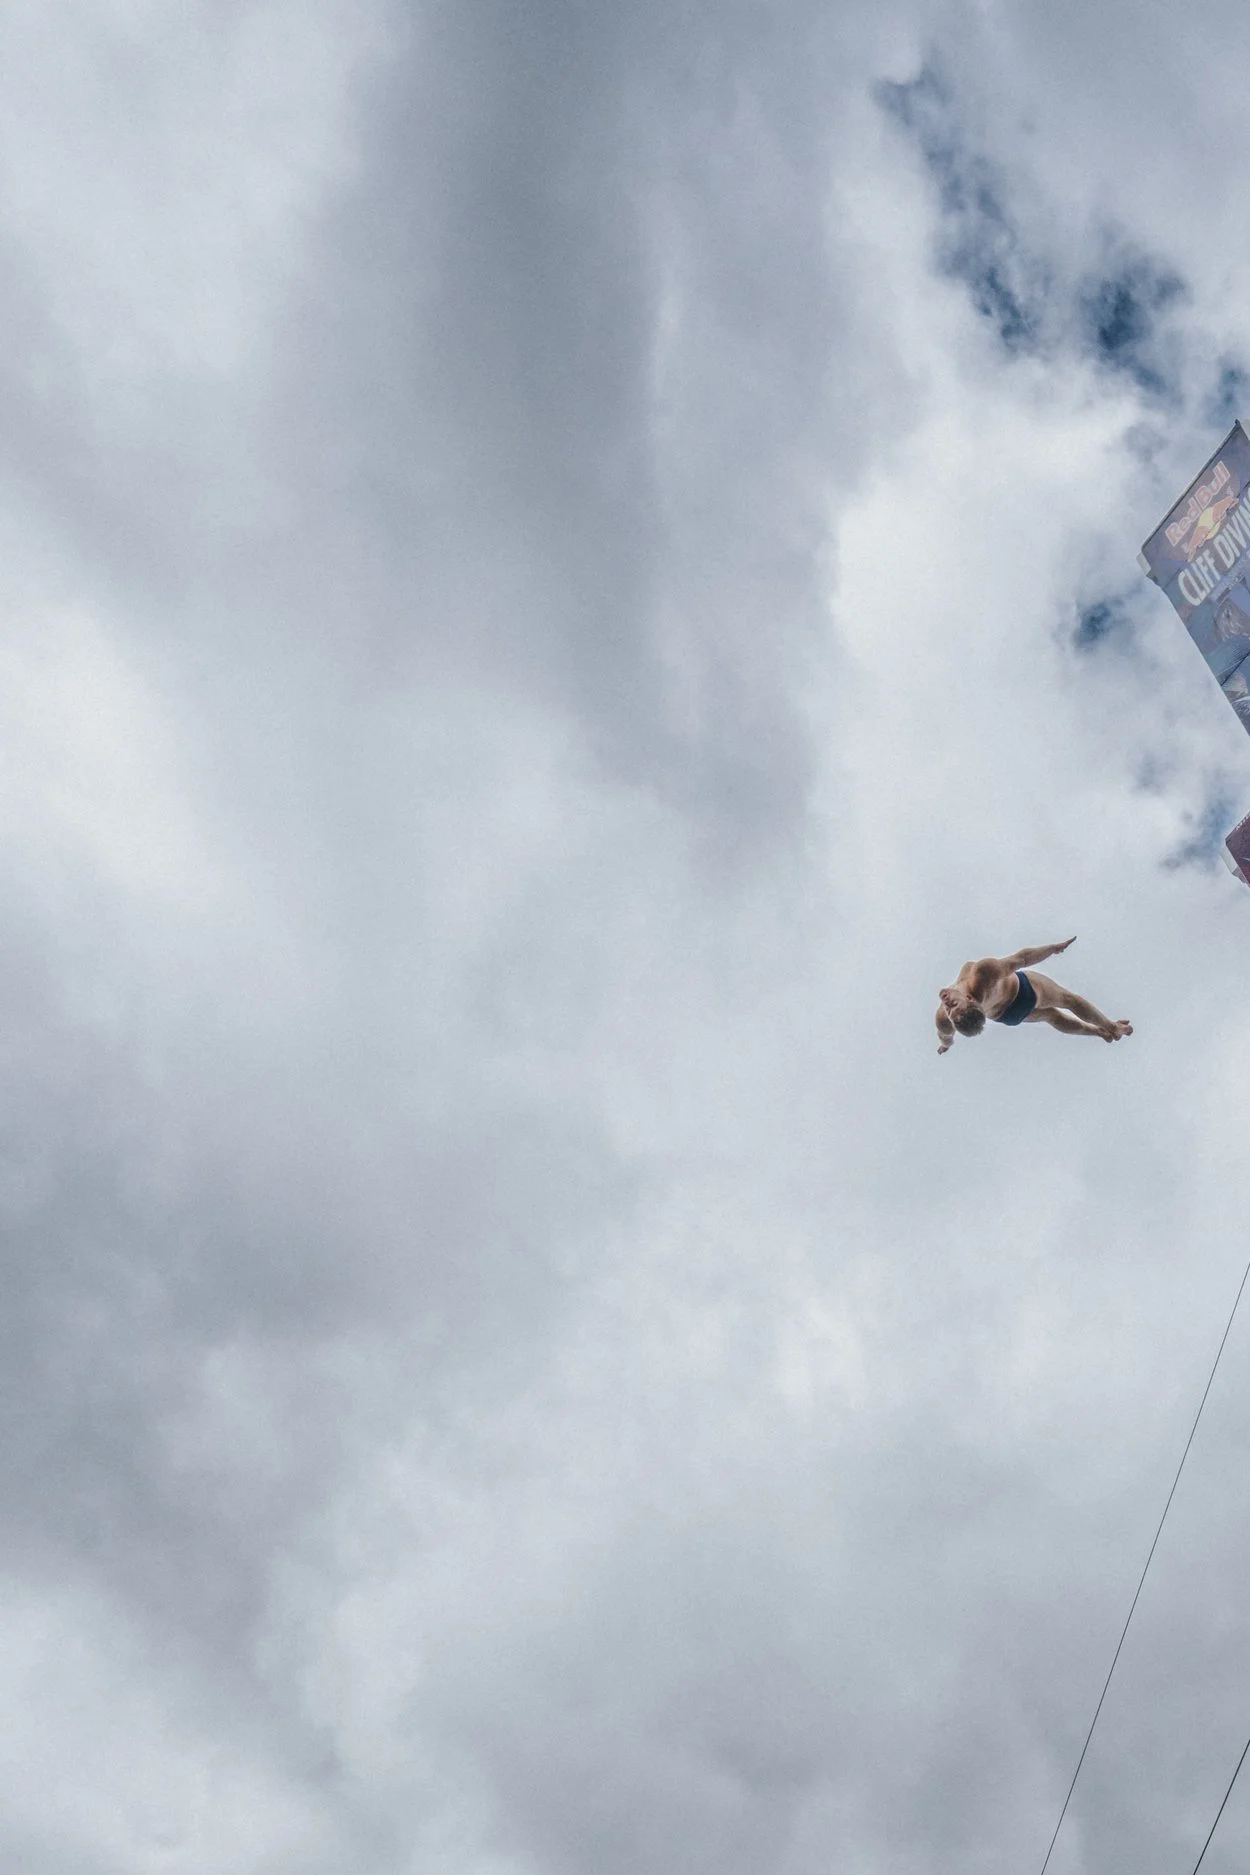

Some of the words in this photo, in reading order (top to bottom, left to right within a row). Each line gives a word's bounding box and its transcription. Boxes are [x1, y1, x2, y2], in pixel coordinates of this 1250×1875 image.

[1165, 497, 1200, 547] Red
[1195, 460, 1231, 506] Bull
[1178, 549, 1221, 606] CLIFF
